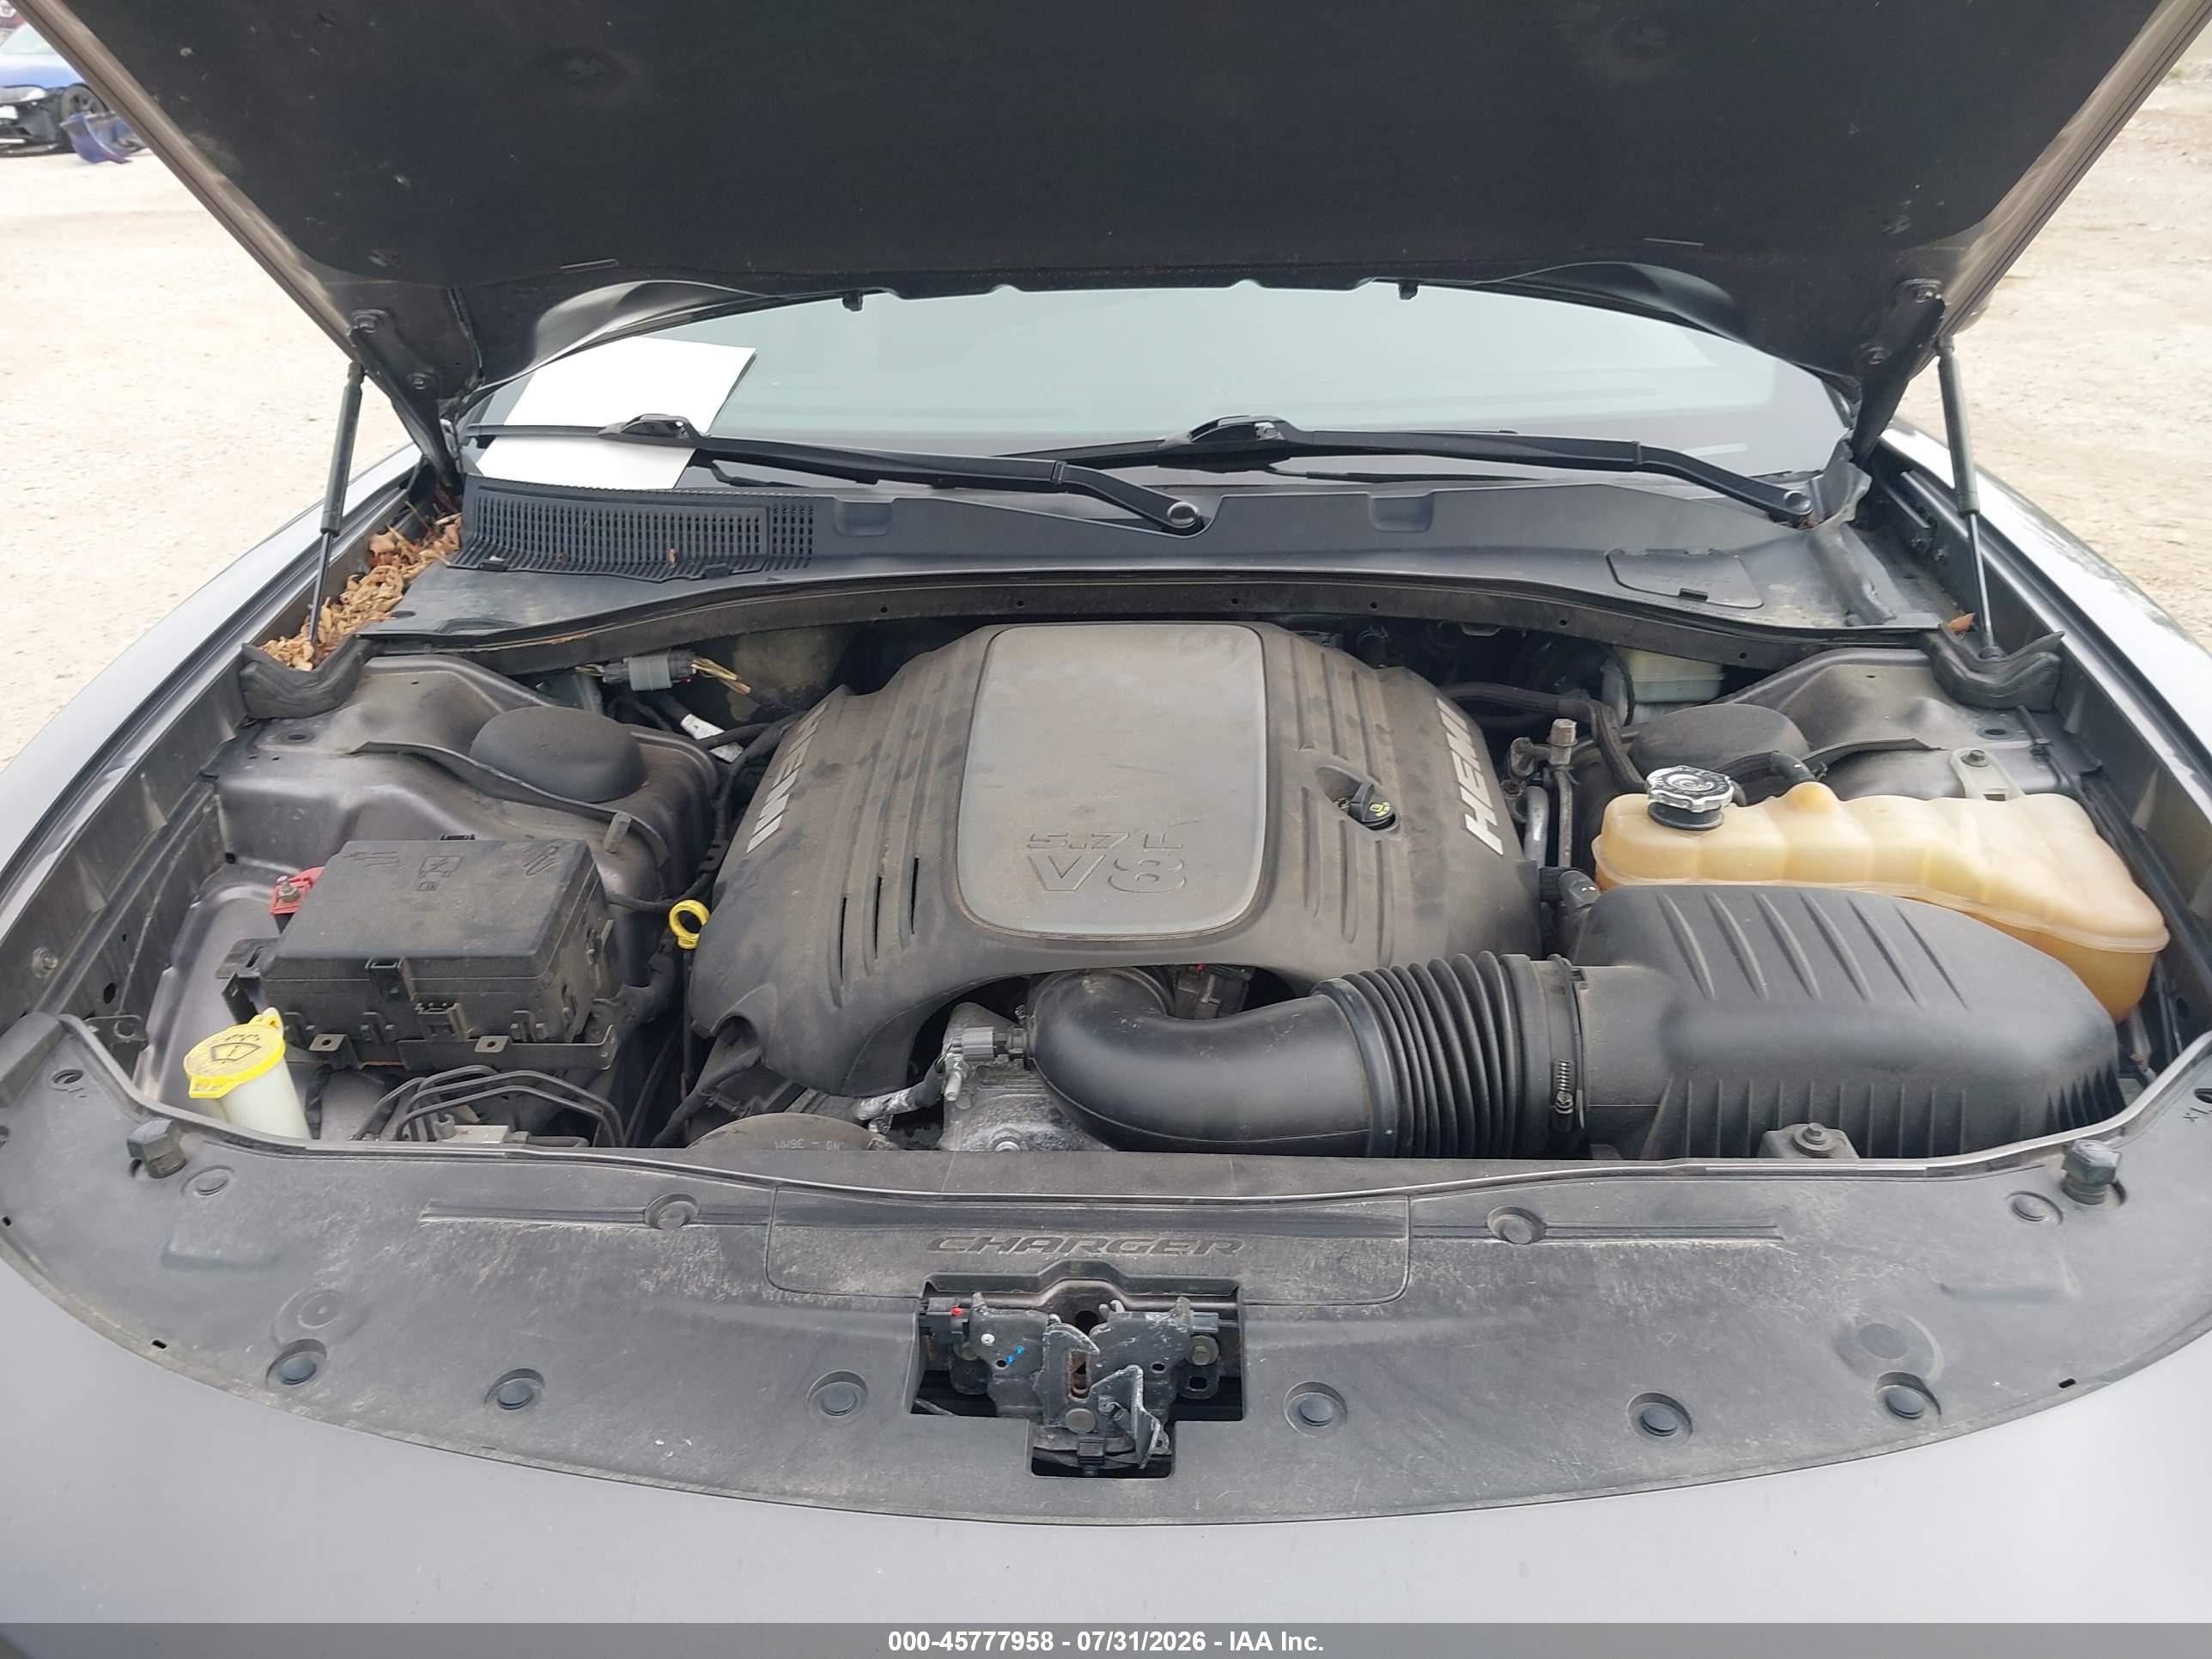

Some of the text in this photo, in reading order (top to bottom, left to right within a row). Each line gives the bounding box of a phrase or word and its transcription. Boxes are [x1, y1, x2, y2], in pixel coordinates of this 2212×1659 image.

[746, 701, 829, 854] HEMI
[1436, 697, 1504, 855] HEMI
[1026, 831, 1183, 849] 5.7L
[1027, 854, 1187, 894] V8
[928, 1235, 1244, 1256] CHARGER
